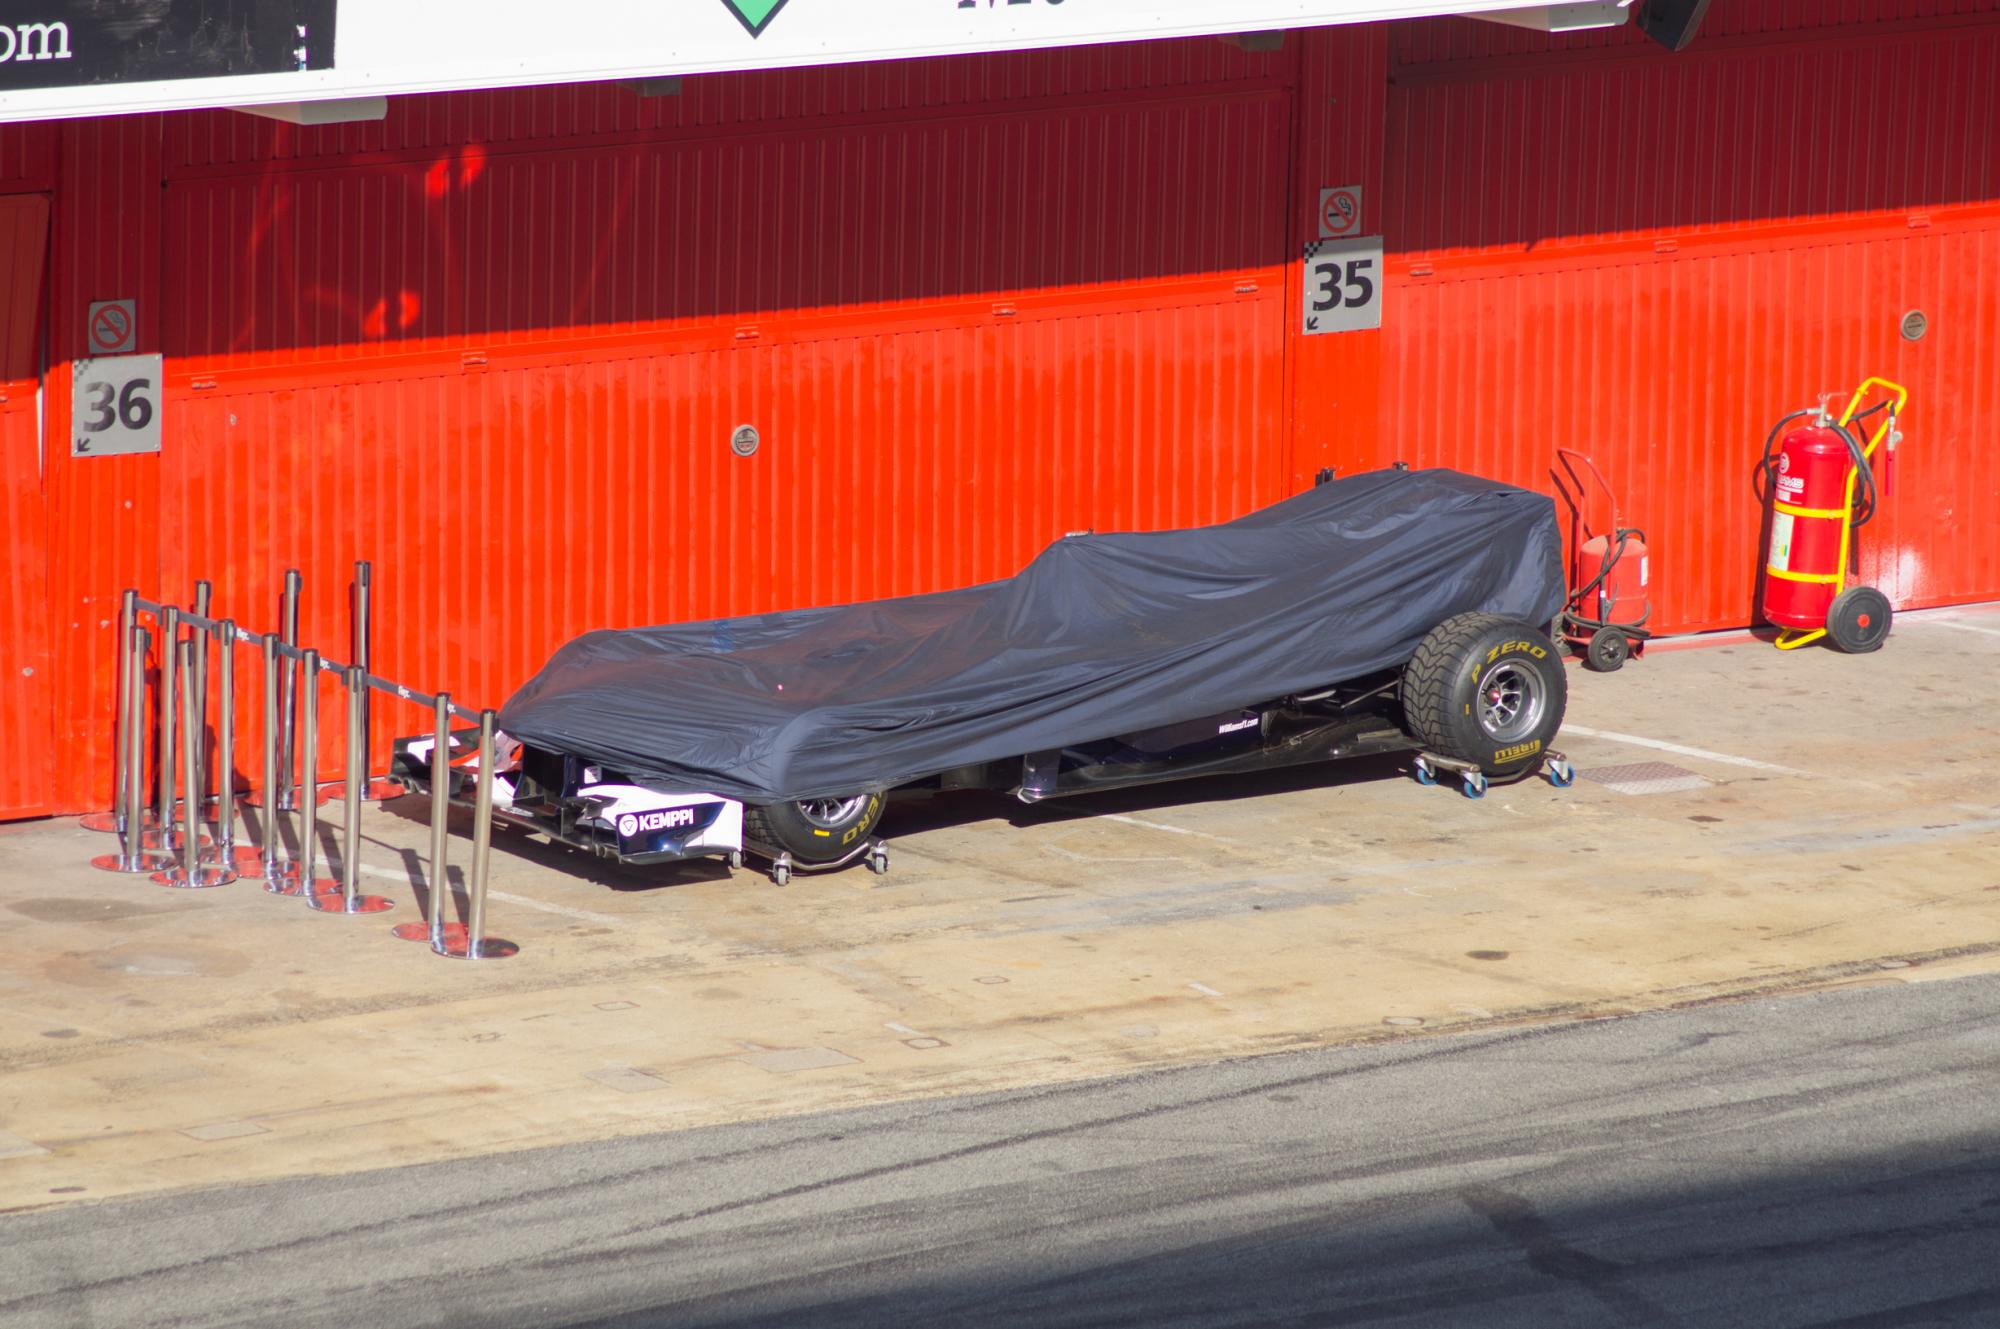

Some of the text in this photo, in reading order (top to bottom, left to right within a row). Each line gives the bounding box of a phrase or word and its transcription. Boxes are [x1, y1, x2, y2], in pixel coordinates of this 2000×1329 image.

[1313, 259, 1373, 312] 35
[83, 378, 153, 432] 36
[1471, 640, 1547, 684] P ZERO
[639, 808, 694, 831] KEMPPI
[842, 793, 881, 845] ERO
